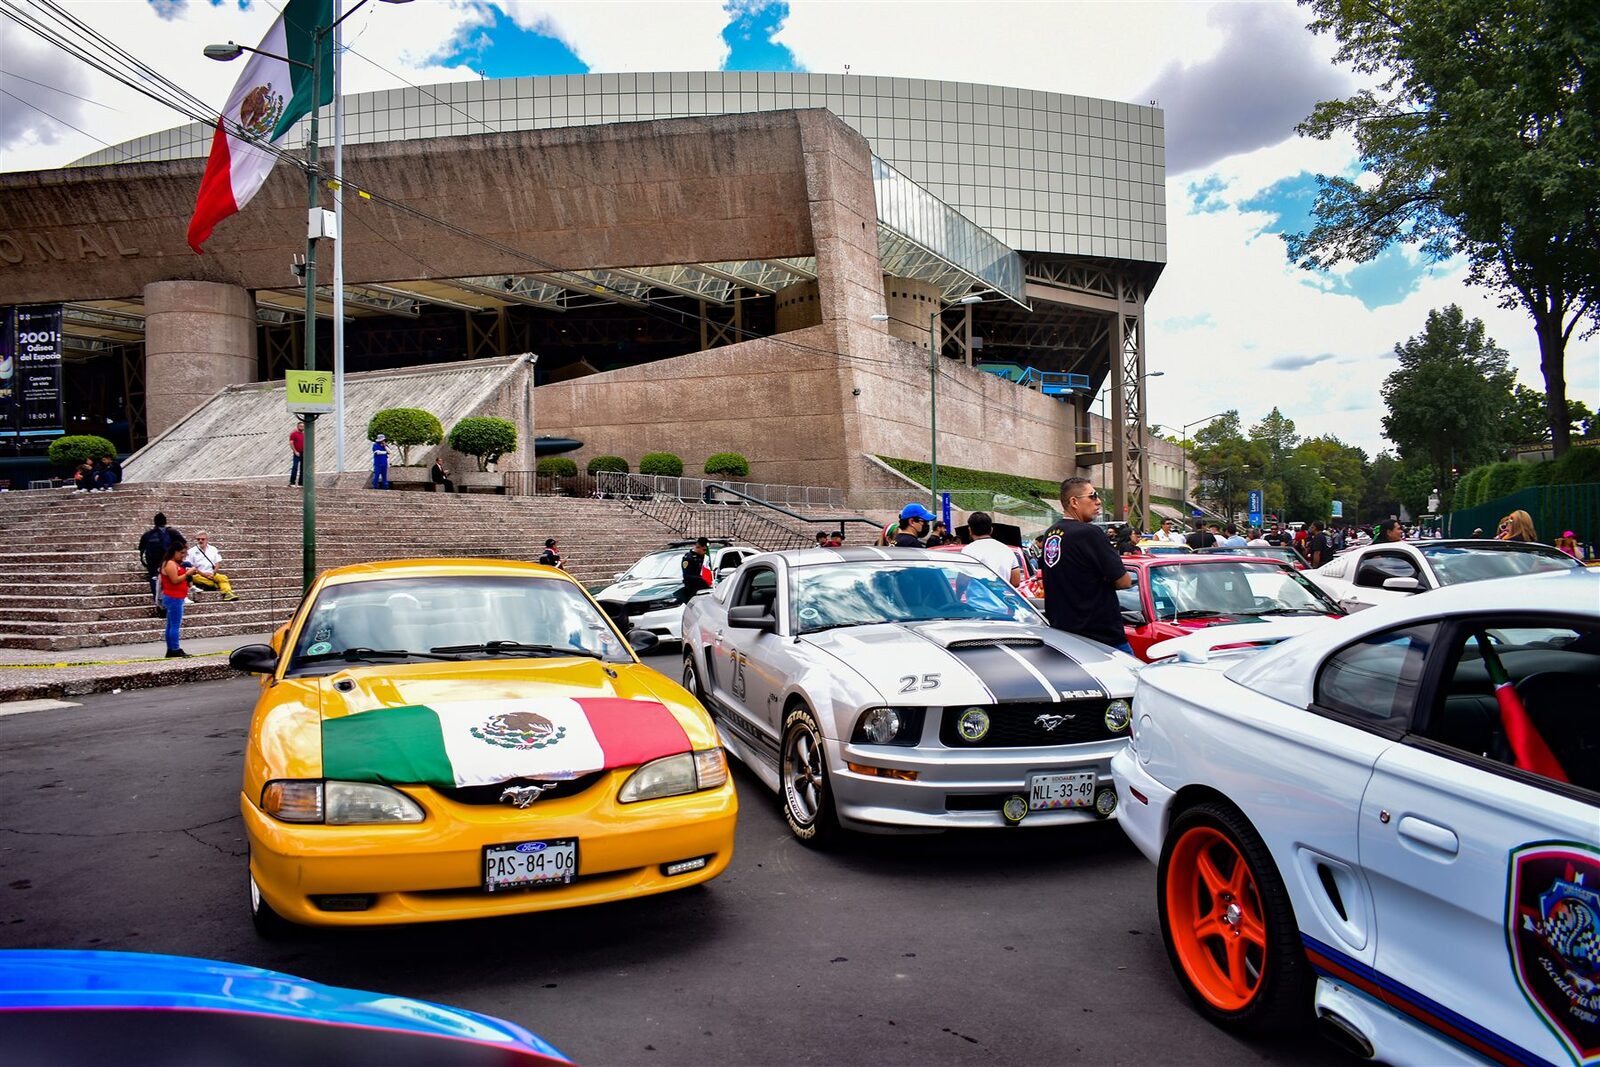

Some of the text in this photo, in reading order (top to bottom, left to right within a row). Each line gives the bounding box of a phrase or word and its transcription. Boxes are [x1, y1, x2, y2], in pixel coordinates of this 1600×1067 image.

[19, 331, 61, 344] 2001:
[27, 344, 54, 352] Odisea
[20, 352, 61, 362] del Espacio
[298, 383, 323, 394] WiFi
[899, 673, 942, 695] 25
[1033, 782, 1093, 800] NLL-33-49
[521, 843, 542, 852] Ford
[487, 851, 574, 877] PAS-84-06
